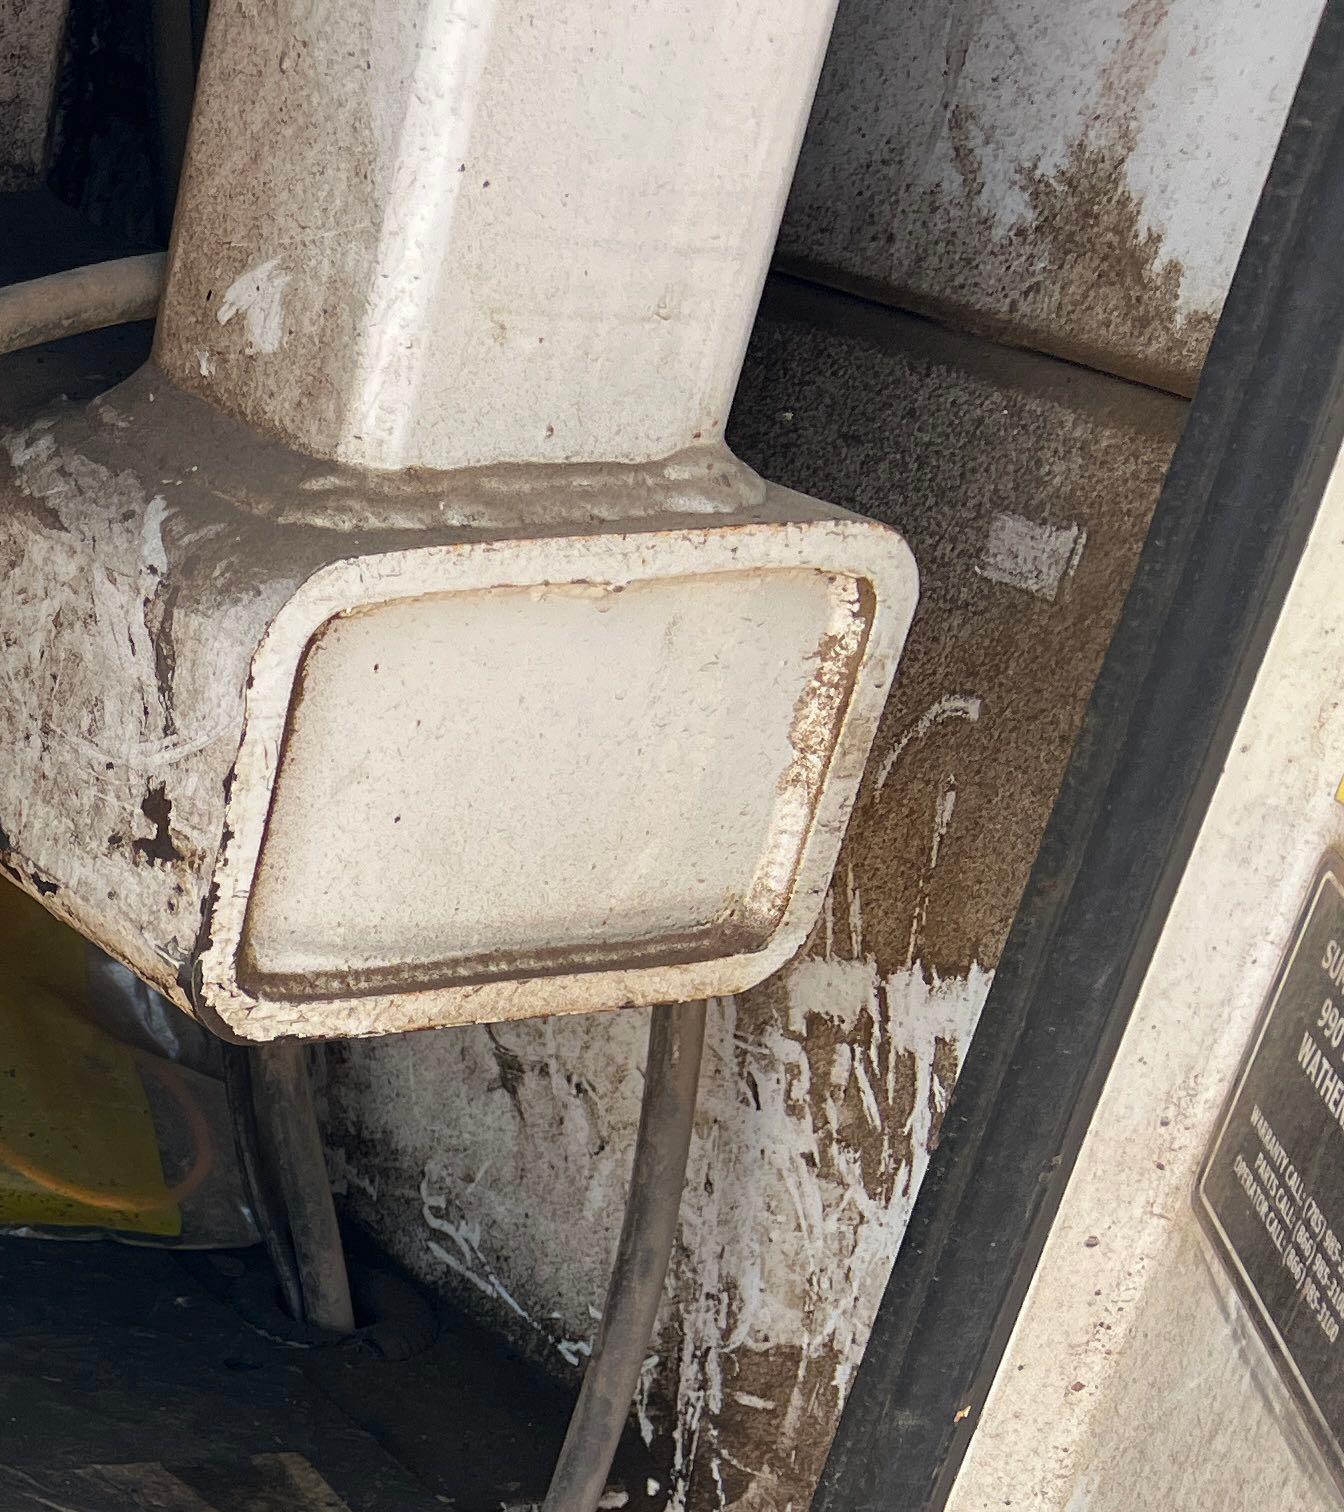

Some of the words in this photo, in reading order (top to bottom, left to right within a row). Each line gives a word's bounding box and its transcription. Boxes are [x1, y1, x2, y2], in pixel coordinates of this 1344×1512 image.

[1317, 998, 1344, 1048] 990
[1250, 1103, 1290, 1173] WARRANTY
[1285, 1164, 1307, 1206] CALL:
[1302, 1196, 1327, 1241] (785)
[1254, 1152, 1280, 1198] PARTS
[1275, 1187, 1297, 1230] CALL:
[1292, 1220, 1316, 1266] (866)
[1234, 1155, 1270, 1222] OPERATOR
[1265, 1211, 1287, 1254] CALL:
[1282, 1243, 1306, 1289] (866)
[1301, 1277, 1339, 1342] 985-3100
